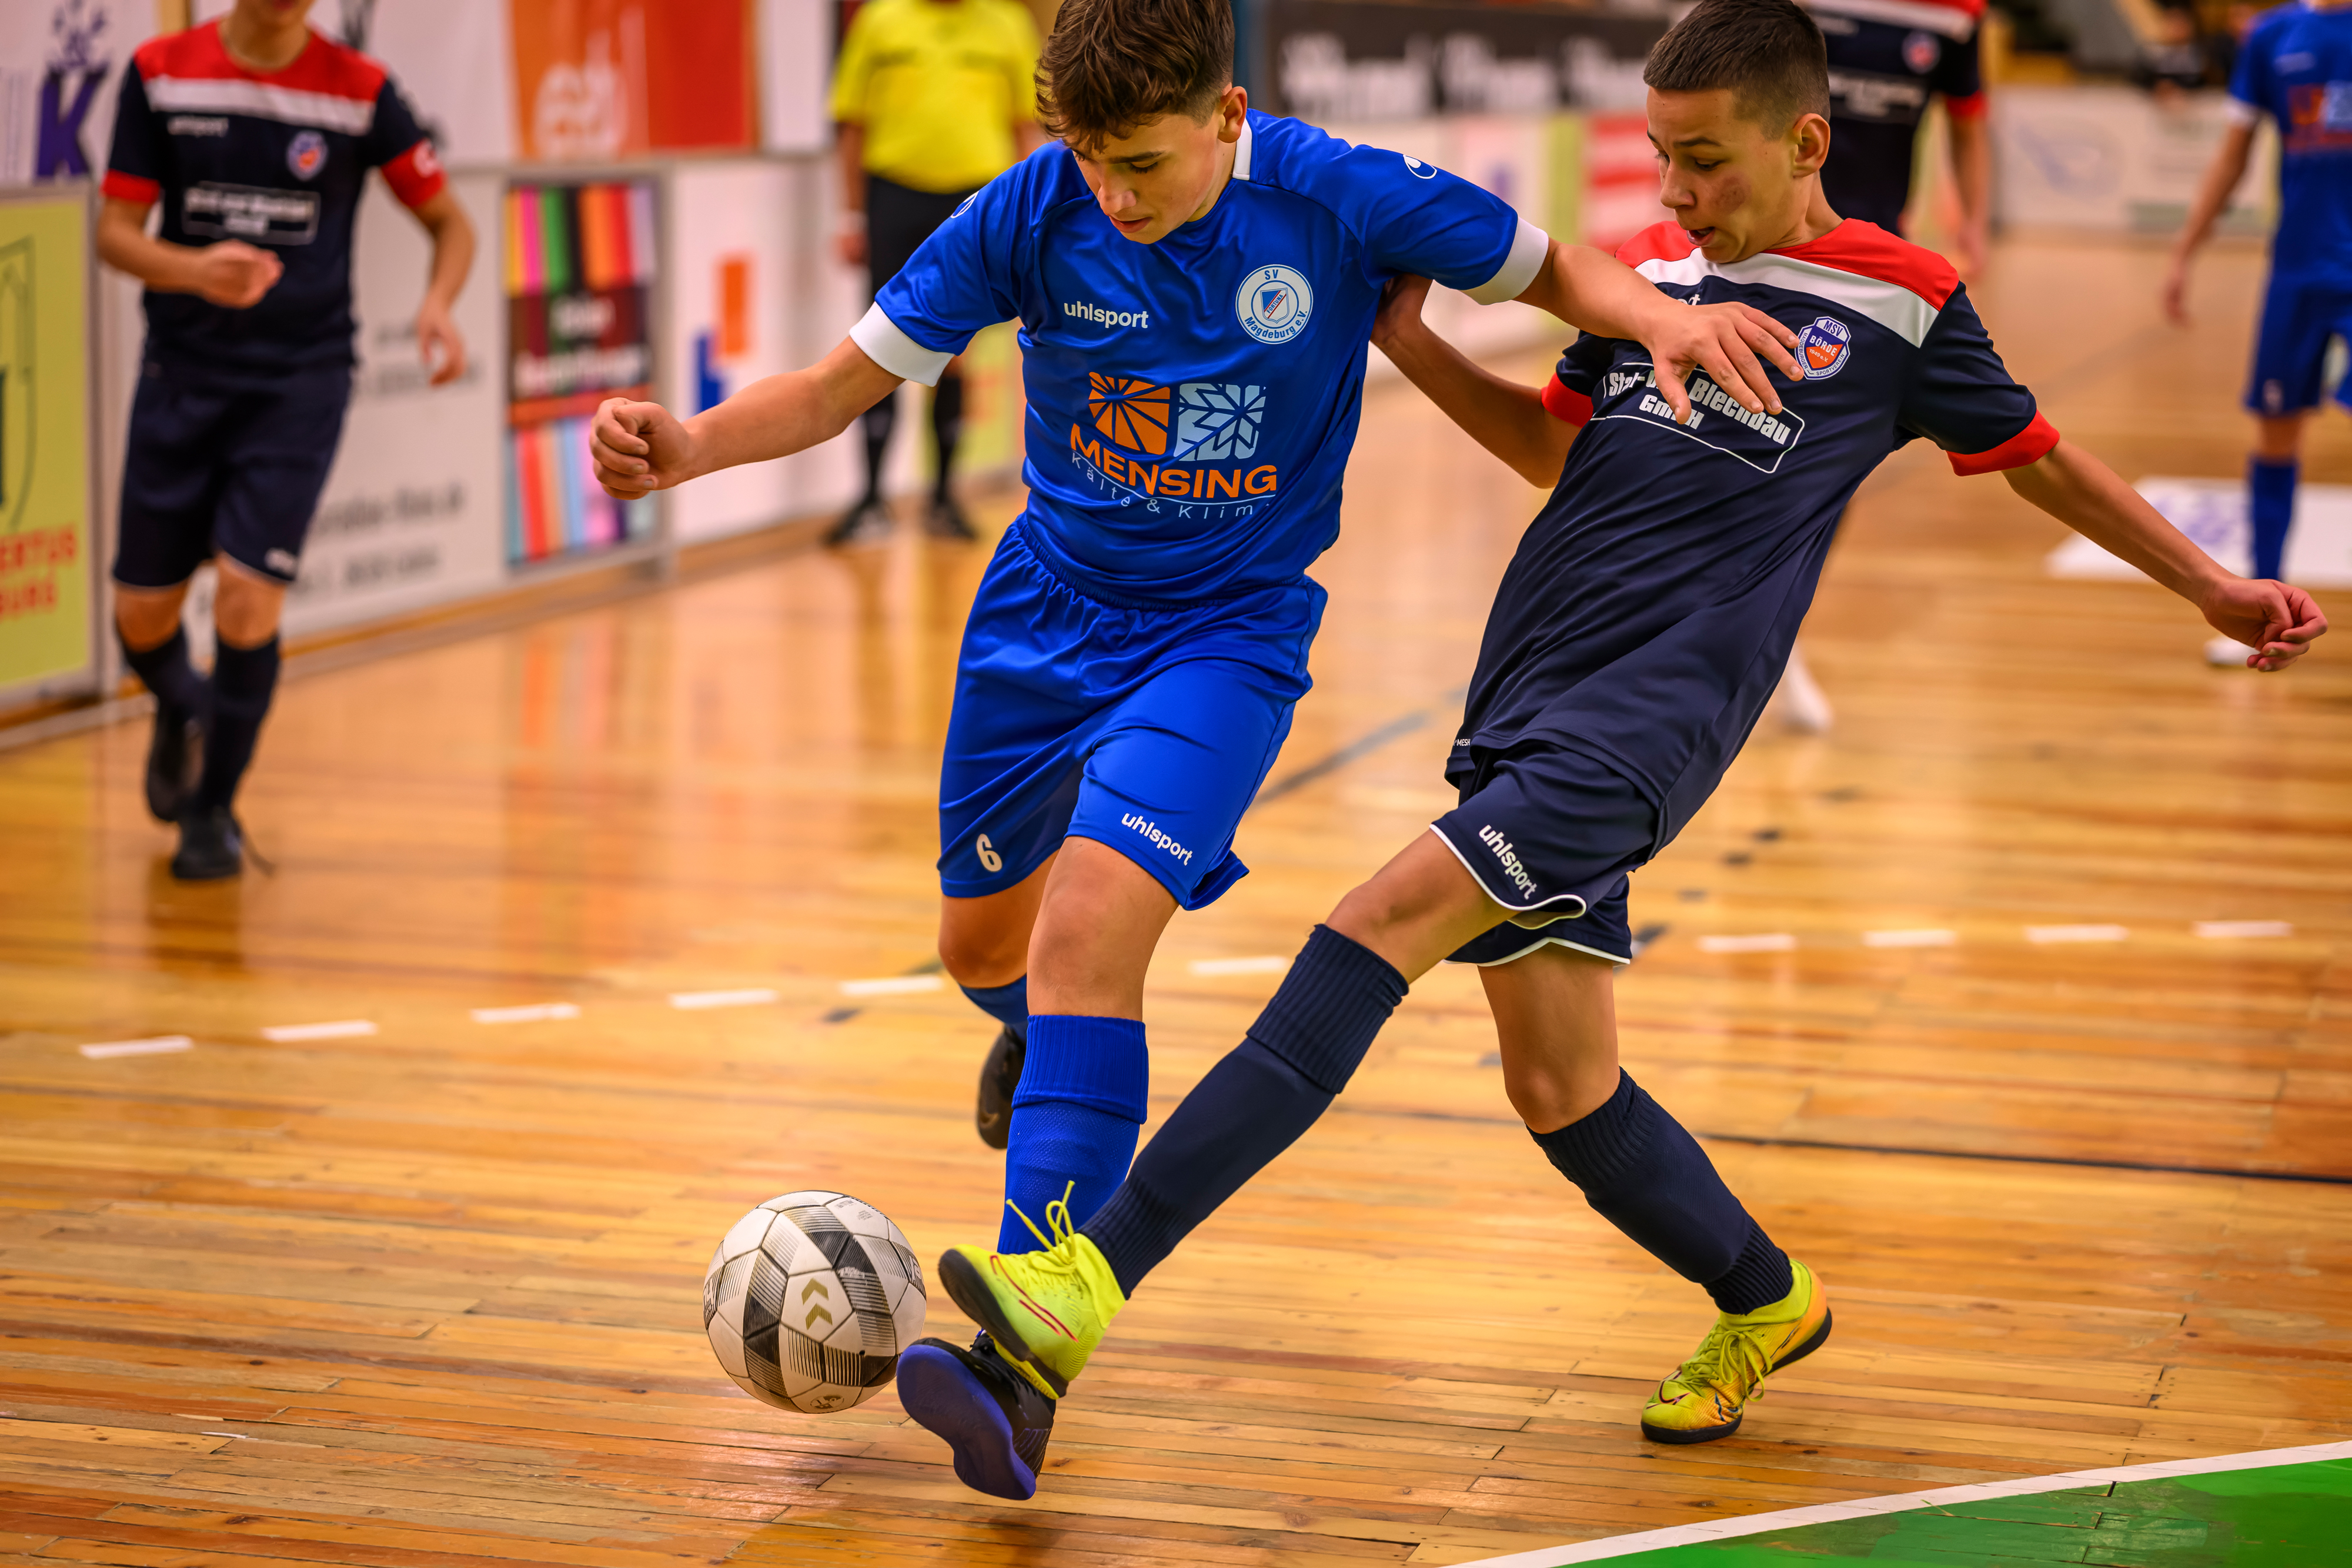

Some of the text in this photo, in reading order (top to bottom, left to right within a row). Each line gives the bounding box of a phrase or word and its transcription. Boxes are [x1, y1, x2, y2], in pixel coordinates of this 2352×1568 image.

[1064, 300, 1149, 329] uhlsport
[1266, 294, 1284, 314] FORTUNA
[1244, 310, 1308, 339] Magdeburg e.V.
[1823, 320, 1843, 337] MSV
[1799, 332, 1808, 369] MAGDEBURGER
[1809, 335, 1838, 357] BÖRDE
[1809, 348, 1821, 358] 1949
[1816, 353, 1845, 376] SPORTVEREIN
[1639, 394, 1705, 430] GmH
[1070, 423, 1277, 499] MENSING
[1072, 452, 1269, 520] Kälte & Klim
[976, 833, 1003, 873] 6
[1121, 813, 1195, 866] uhlsport
[1478, 824, 1538, 900] uhlsport
